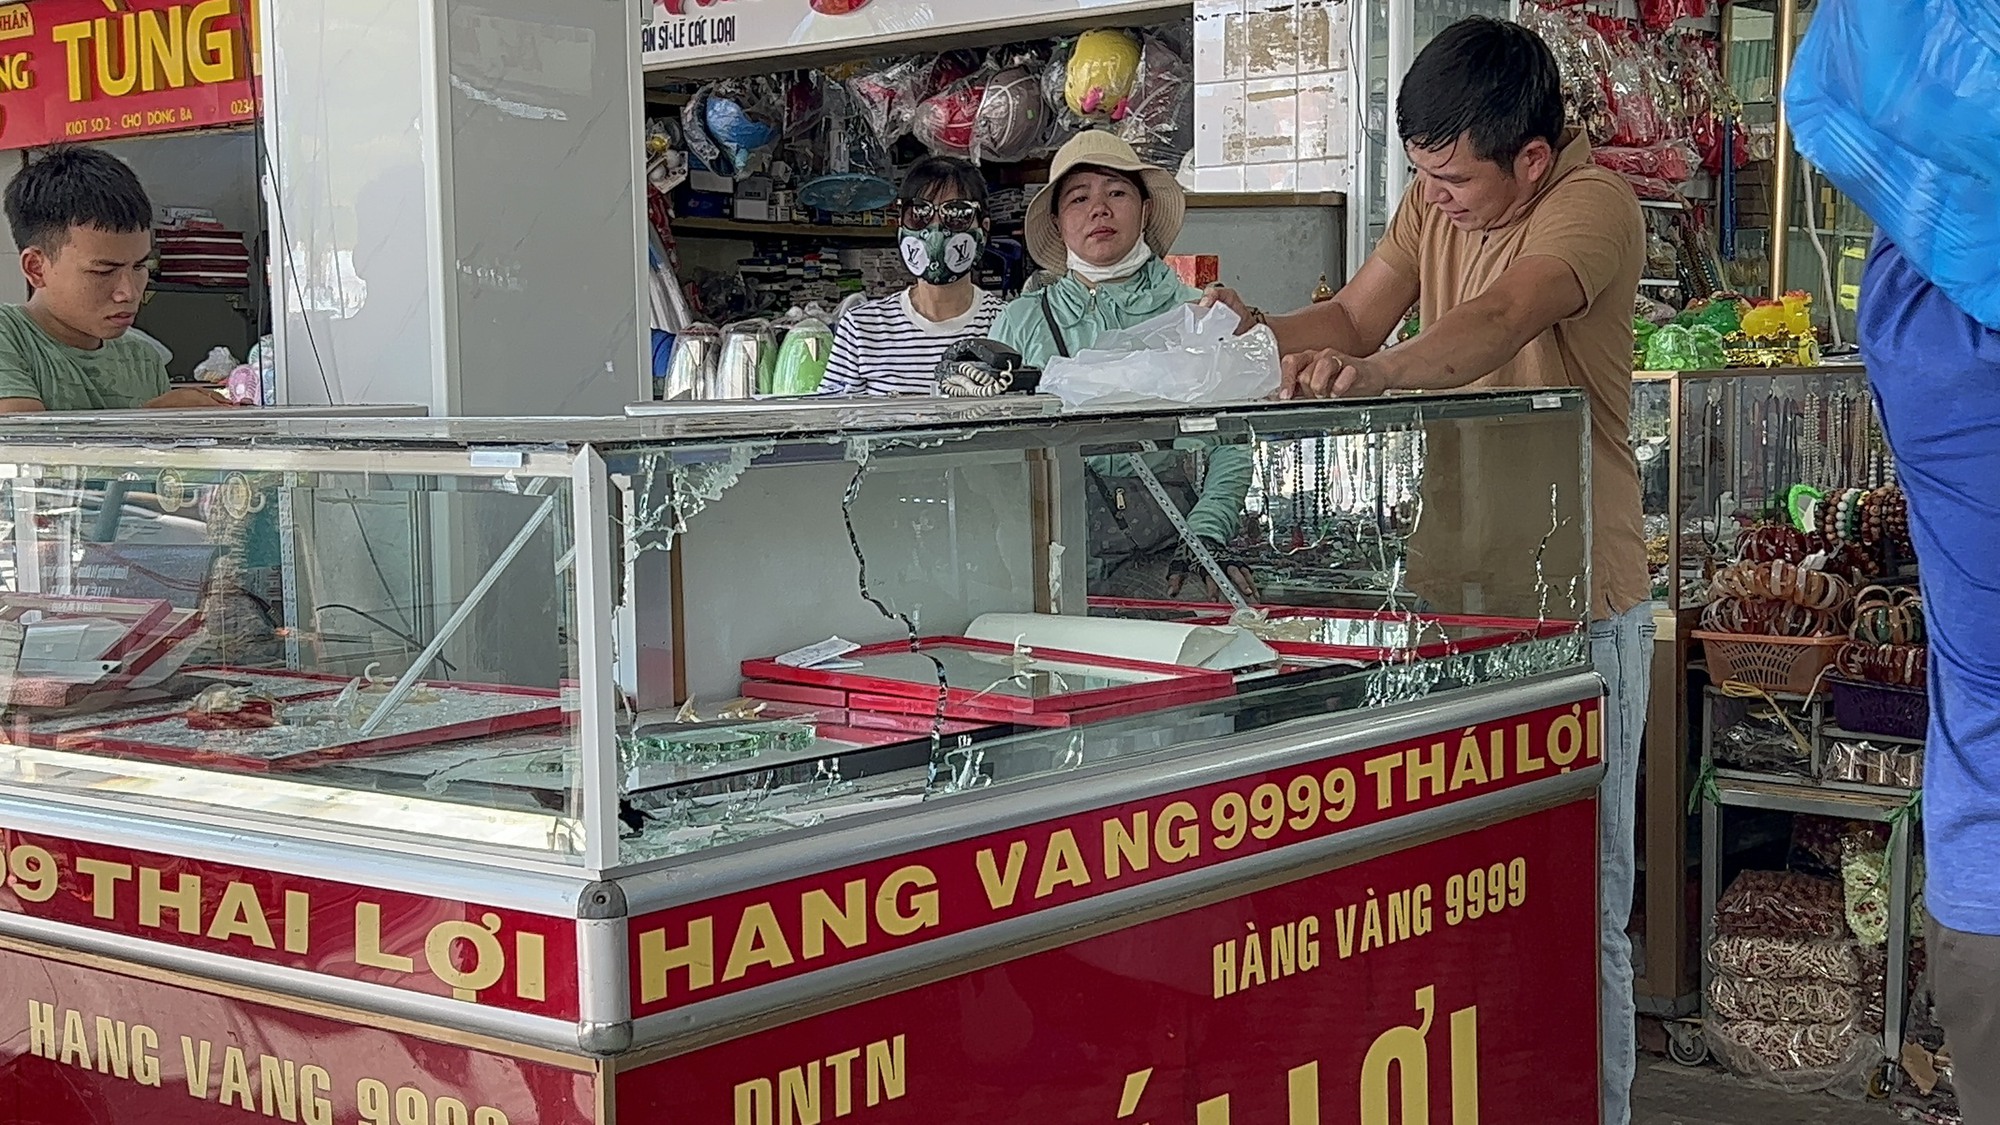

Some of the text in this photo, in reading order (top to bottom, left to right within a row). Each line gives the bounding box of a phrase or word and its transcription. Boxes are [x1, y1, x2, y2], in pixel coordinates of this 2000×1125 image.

[53, 0, 235, 102] TÙNG
[688, 15, 707, 47] CÁC
[711, 15, 736, 47] LOẠI
[640, 704, 1598, 1004] HANG VANG 9999 THÁI LỢI
[0, 840, 545, 1002] 9 THAI LỢI
[1212, 856, 1527, 999] HÀNG VÀNG 9999
[28, 999, 510, 1125] HANG VANG 99
[734, 1033, 906, 1125] DNTN
